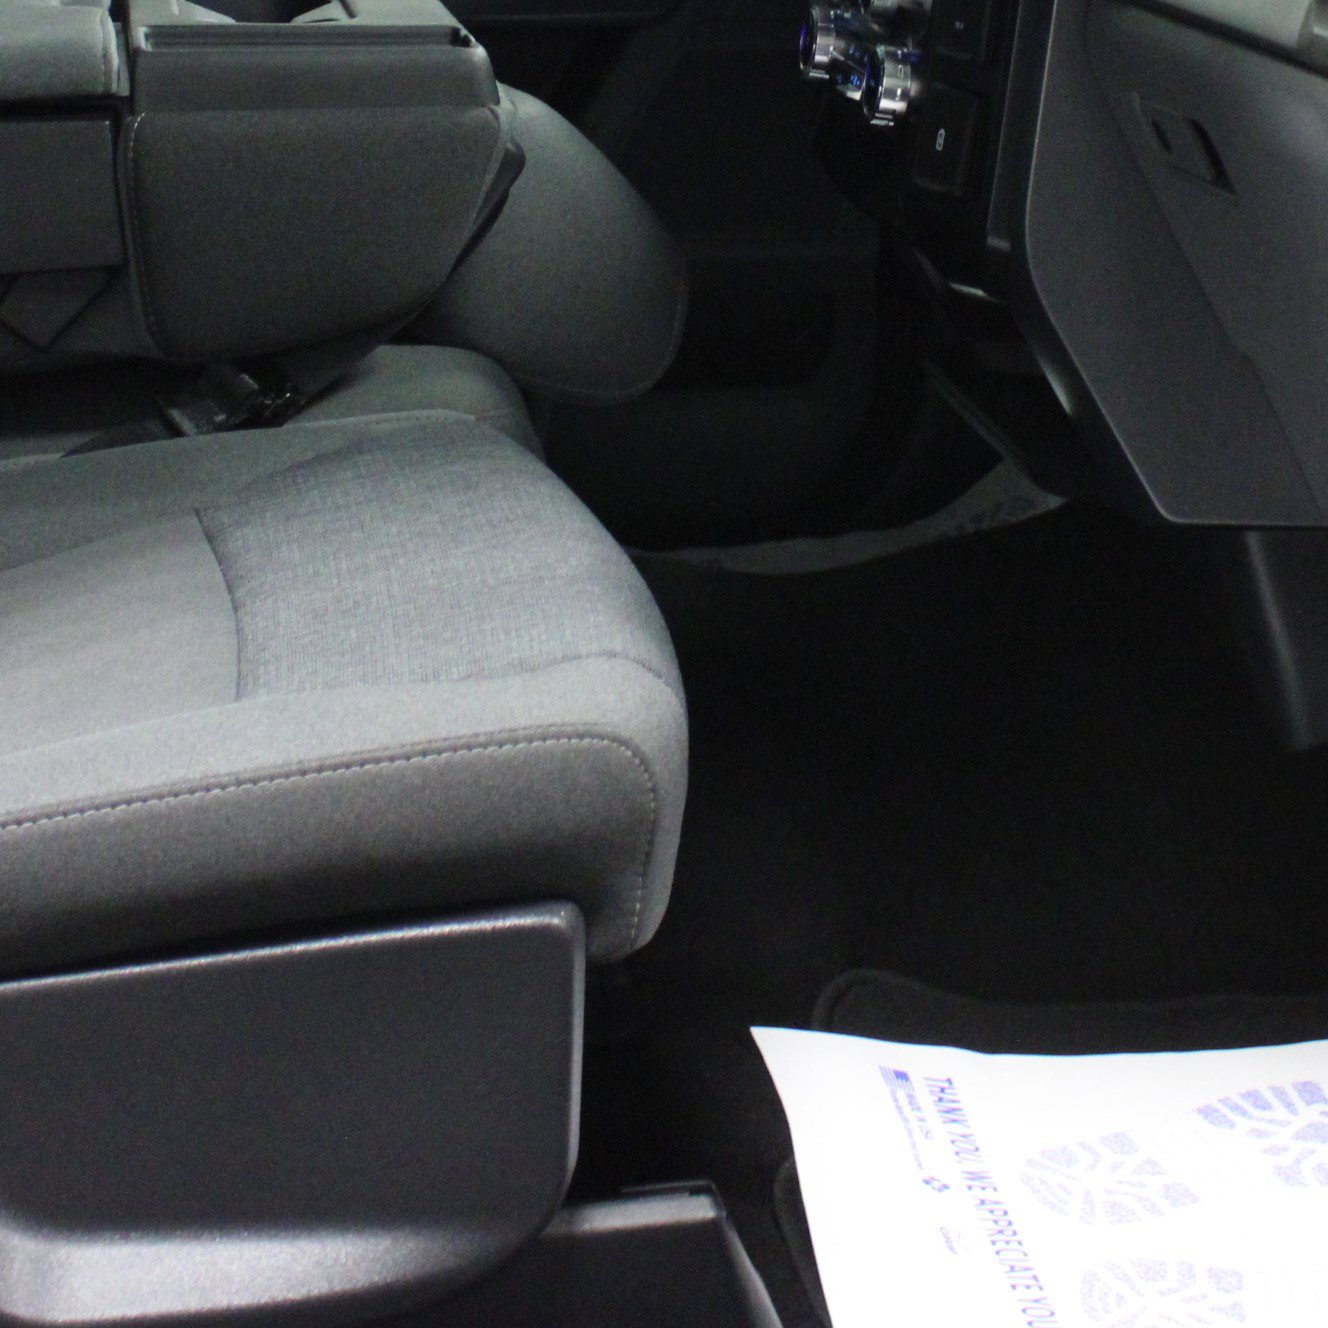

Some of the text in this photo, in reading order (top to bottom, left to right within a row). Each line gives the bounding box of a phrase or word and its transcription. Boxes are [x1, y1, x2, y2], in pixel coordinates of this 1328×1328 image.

[923, 1076, 971, 1128] THANK
[961, 1171, 998, 1192] WE
[973, 1196, 1044, 1292] APPRECIATE
